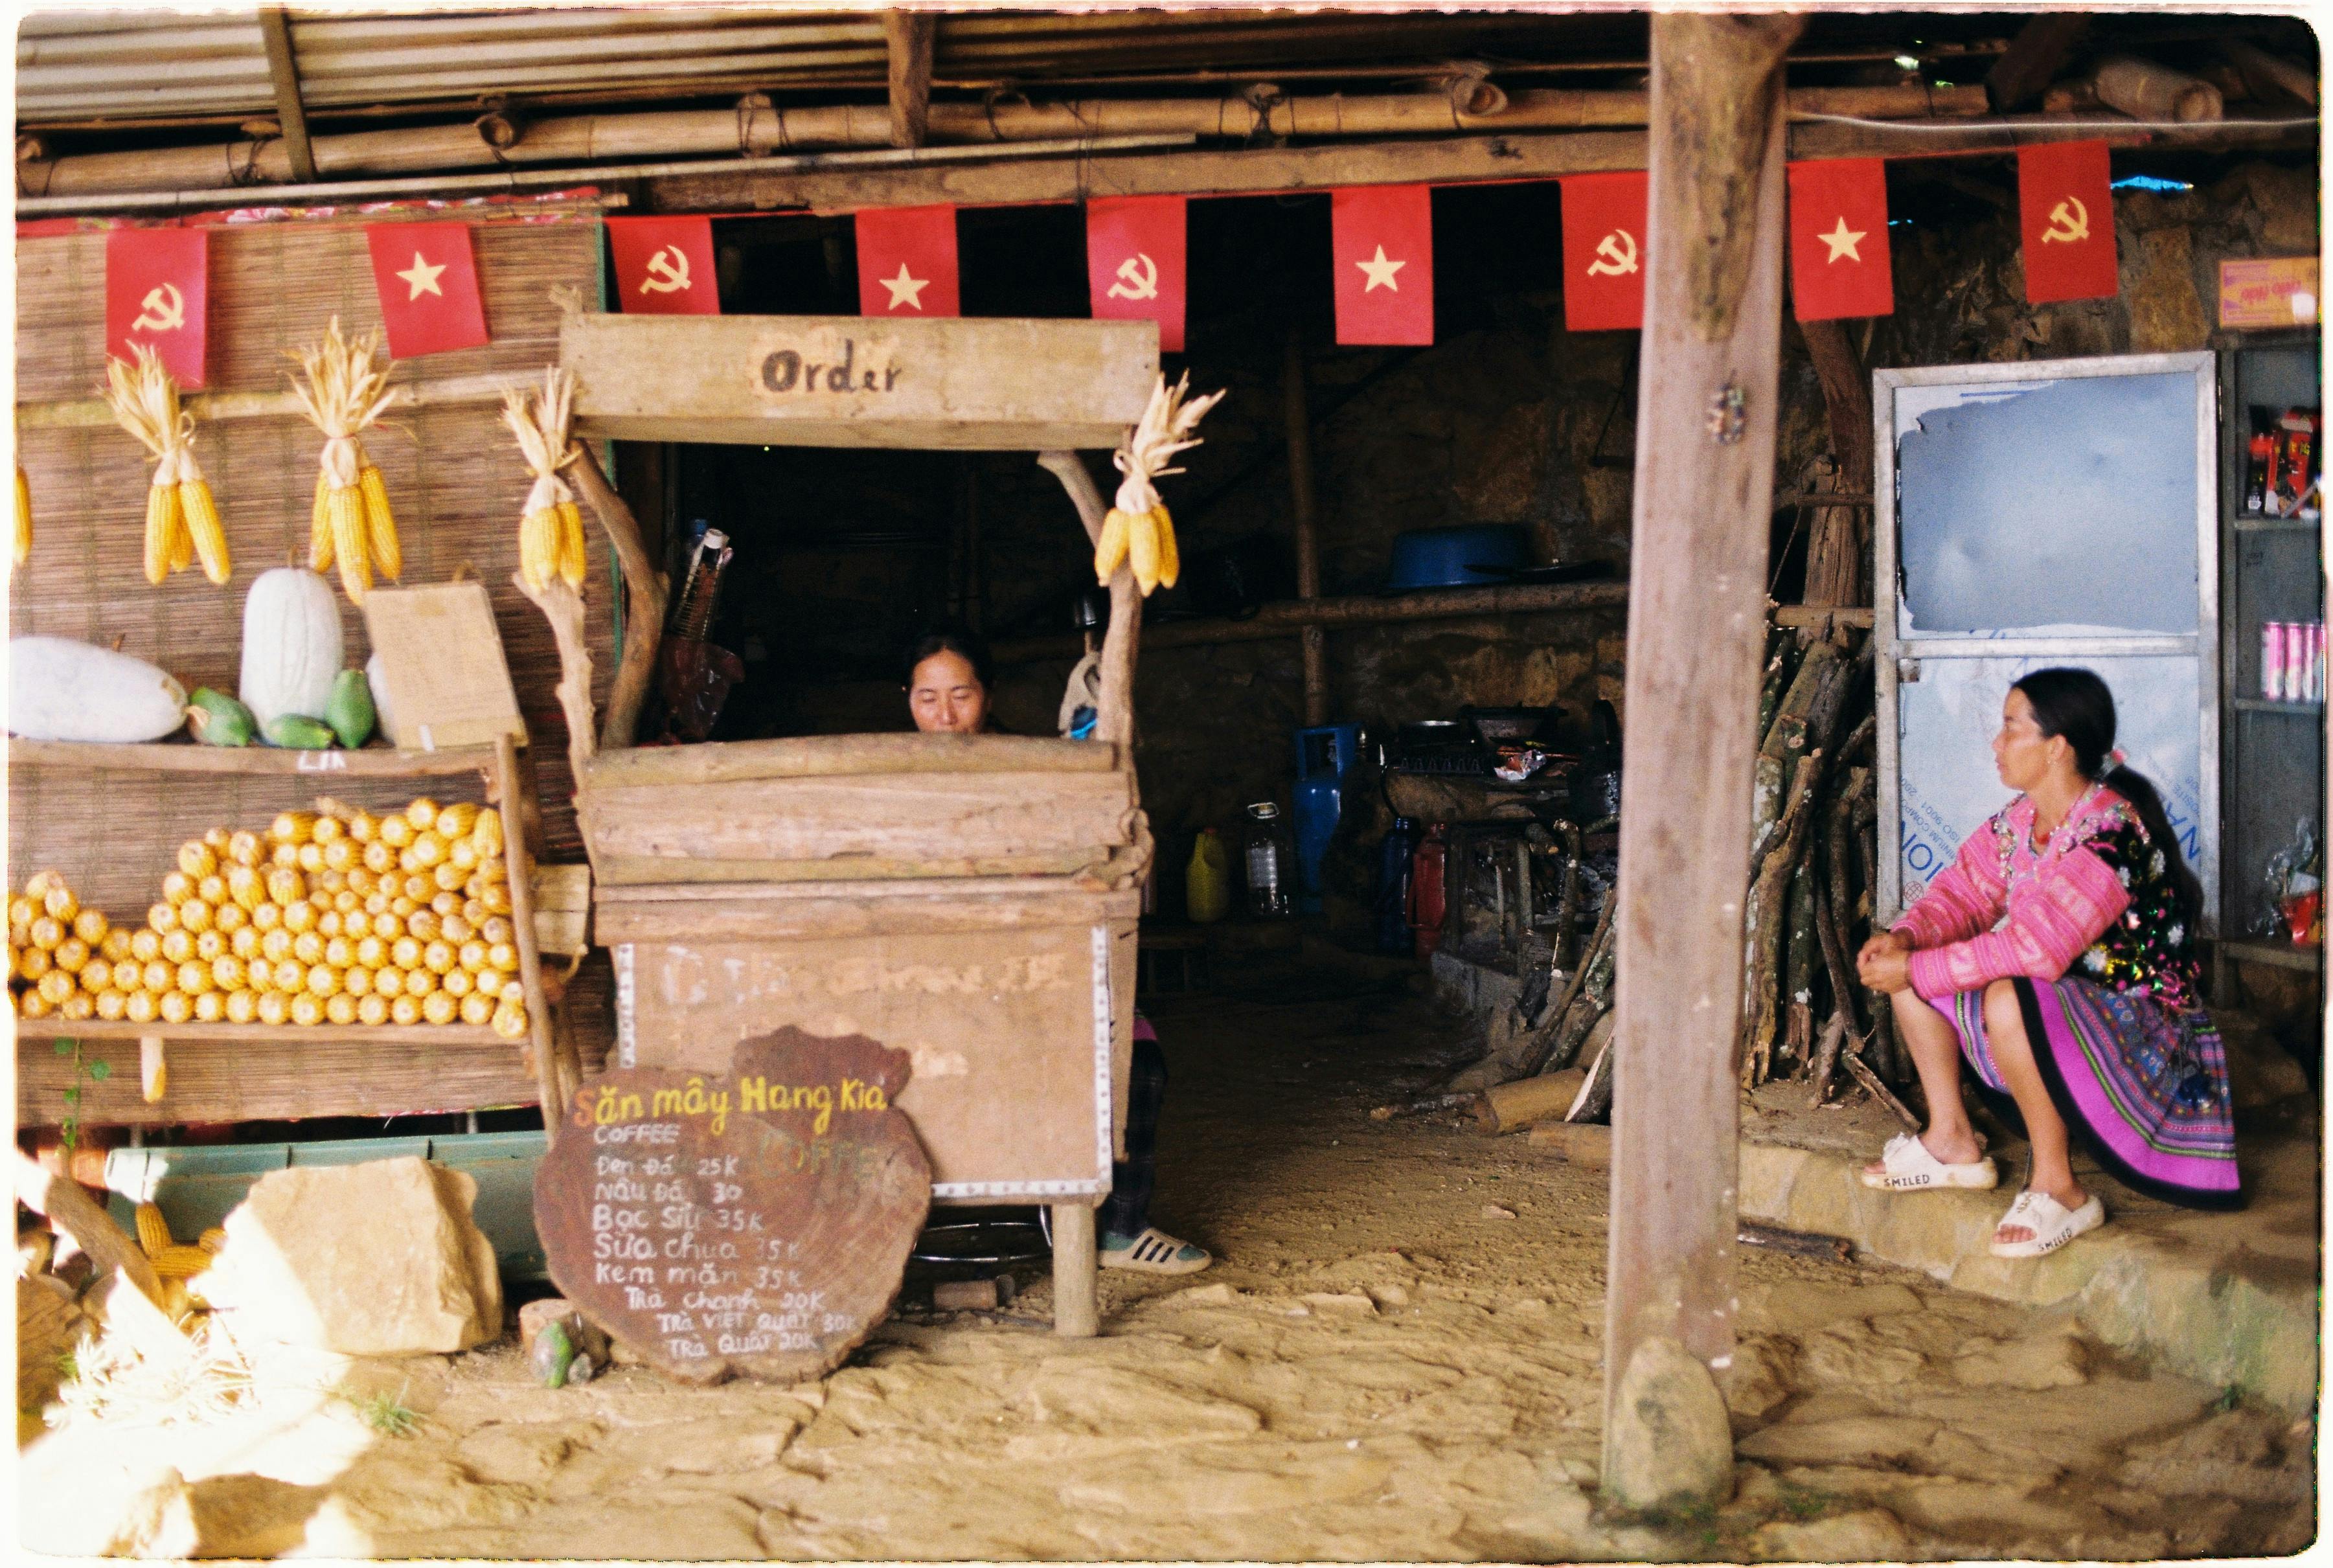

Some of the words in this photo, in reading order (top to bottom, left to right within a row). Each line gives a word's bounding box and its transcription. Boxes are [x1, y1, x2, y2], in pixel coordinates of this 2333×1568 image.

[761, 337, 902, 393] Order
[573, 1084, 646, 1127] Săn
[652, 1076, 733, 1137] mây
[740, 1076, 833, 1135] Hang
[840, 1076, 888, 1113] Kia
[712, 1181, 744, 1204] 30
[1883, 1174, 1930, 1187] SMILED
[2038, 1228, 2072, 1252] SMILED
